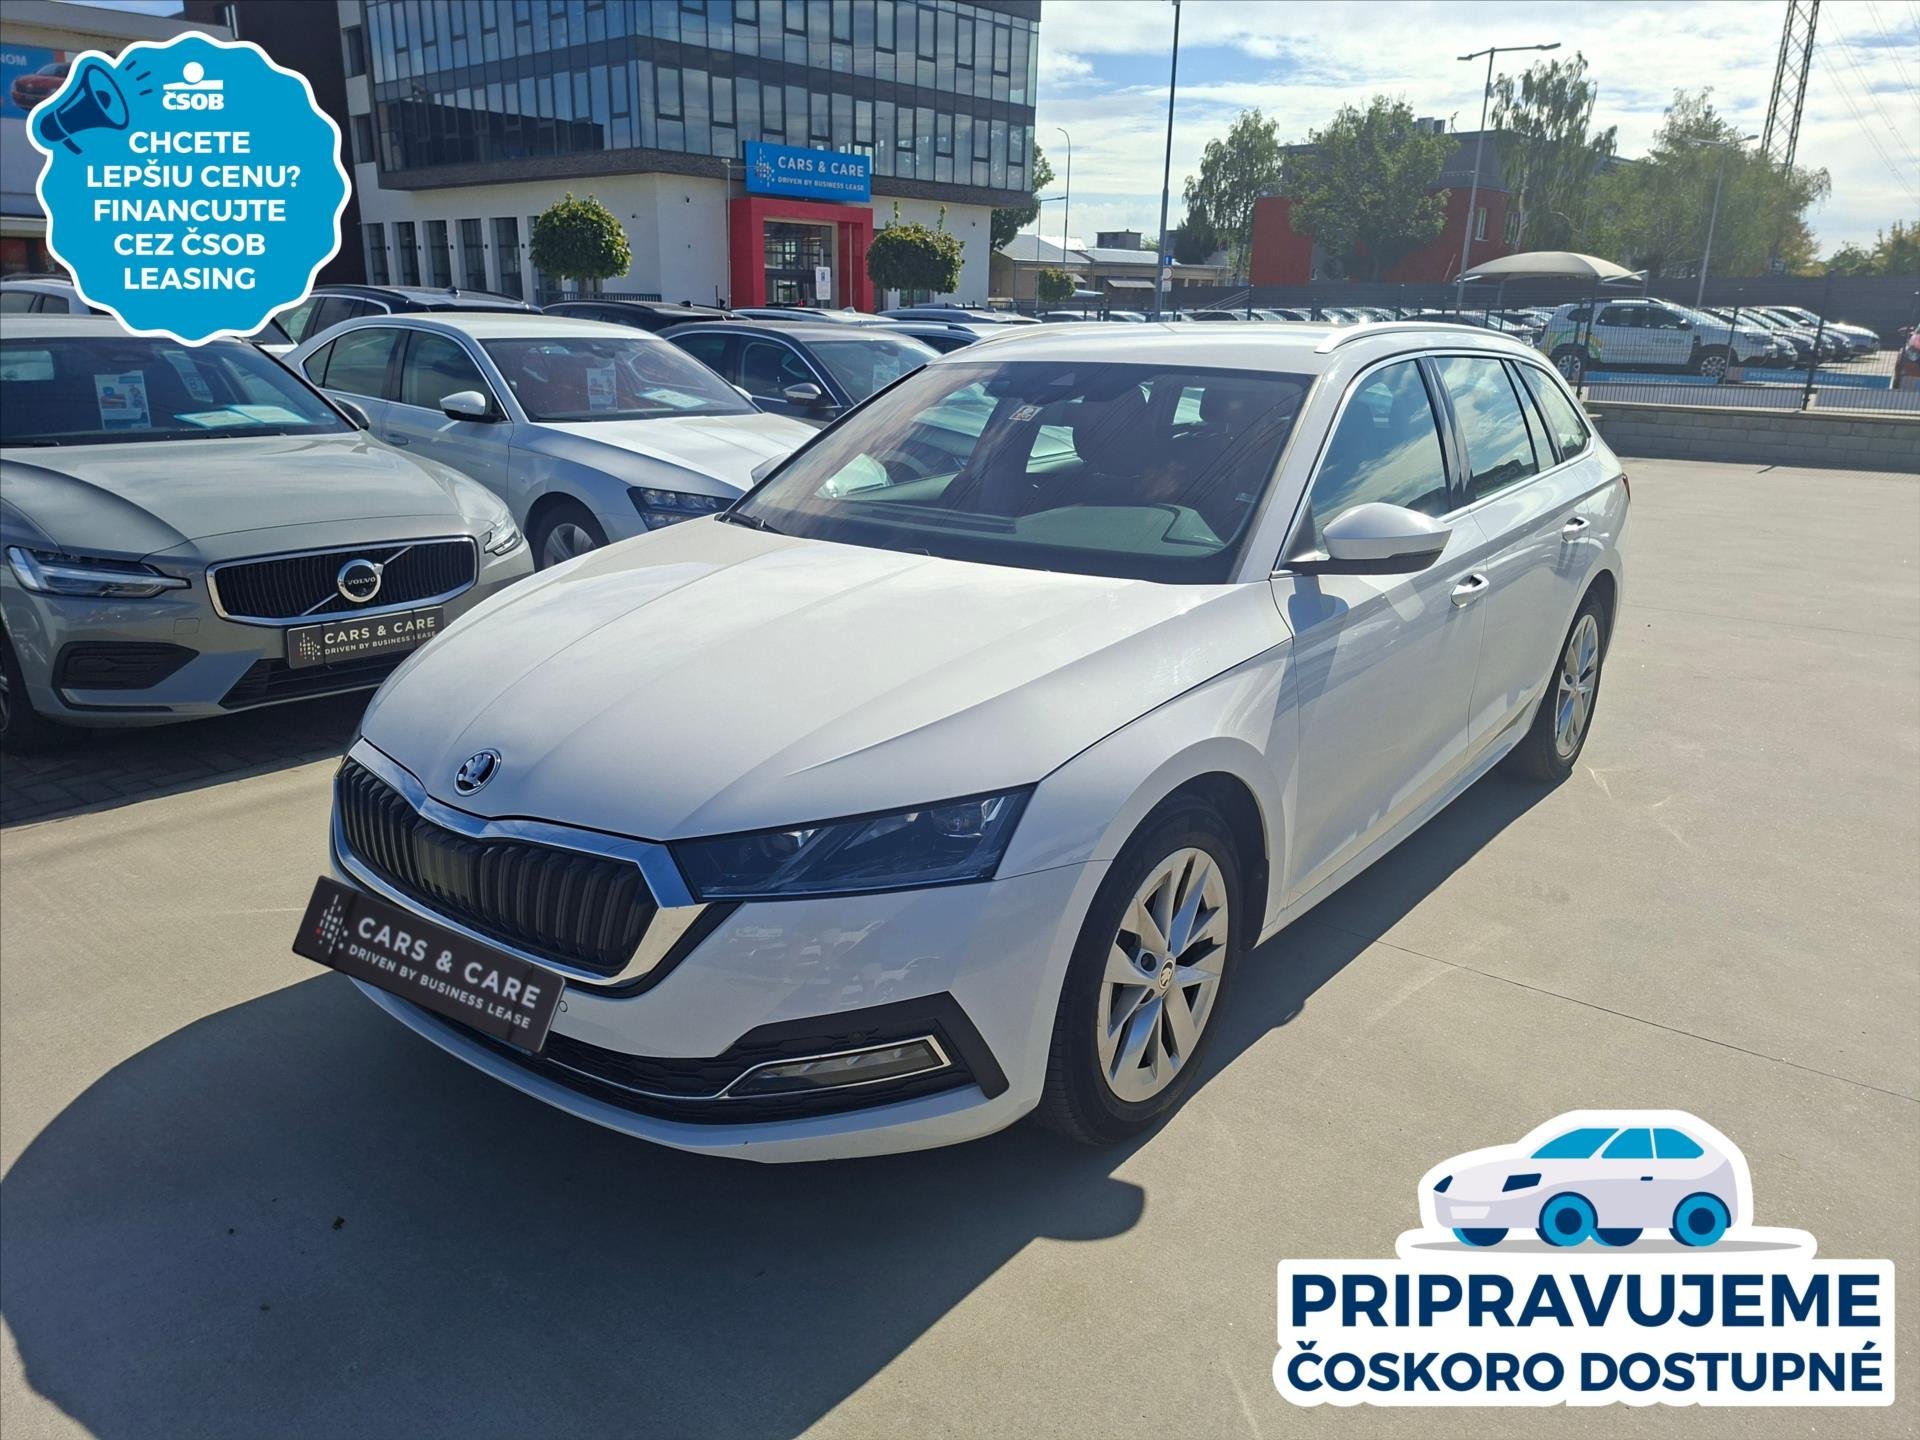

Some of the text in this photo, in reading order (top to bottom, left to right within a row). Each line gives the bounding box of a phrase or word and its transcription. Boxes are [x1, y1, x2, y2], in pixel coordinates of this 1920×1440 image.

[778, 156, 864, 177] CARS & CARE
[778, 176, 802, 185] DRIVEN
[814, 180, 844, 189] BUSINESS
[347, 576, 376, 585] VOLVO
[324, 616, 436, 644] CARS & CARE
[325, 644, 356, 655] DRIVEN
[372, 635, 410, 647] BUSINESS
[358, 917, 542, 1009] CARS & CARE
[349, 944, 532, 1029] DRIVEN BY BUSINESS LEASE
